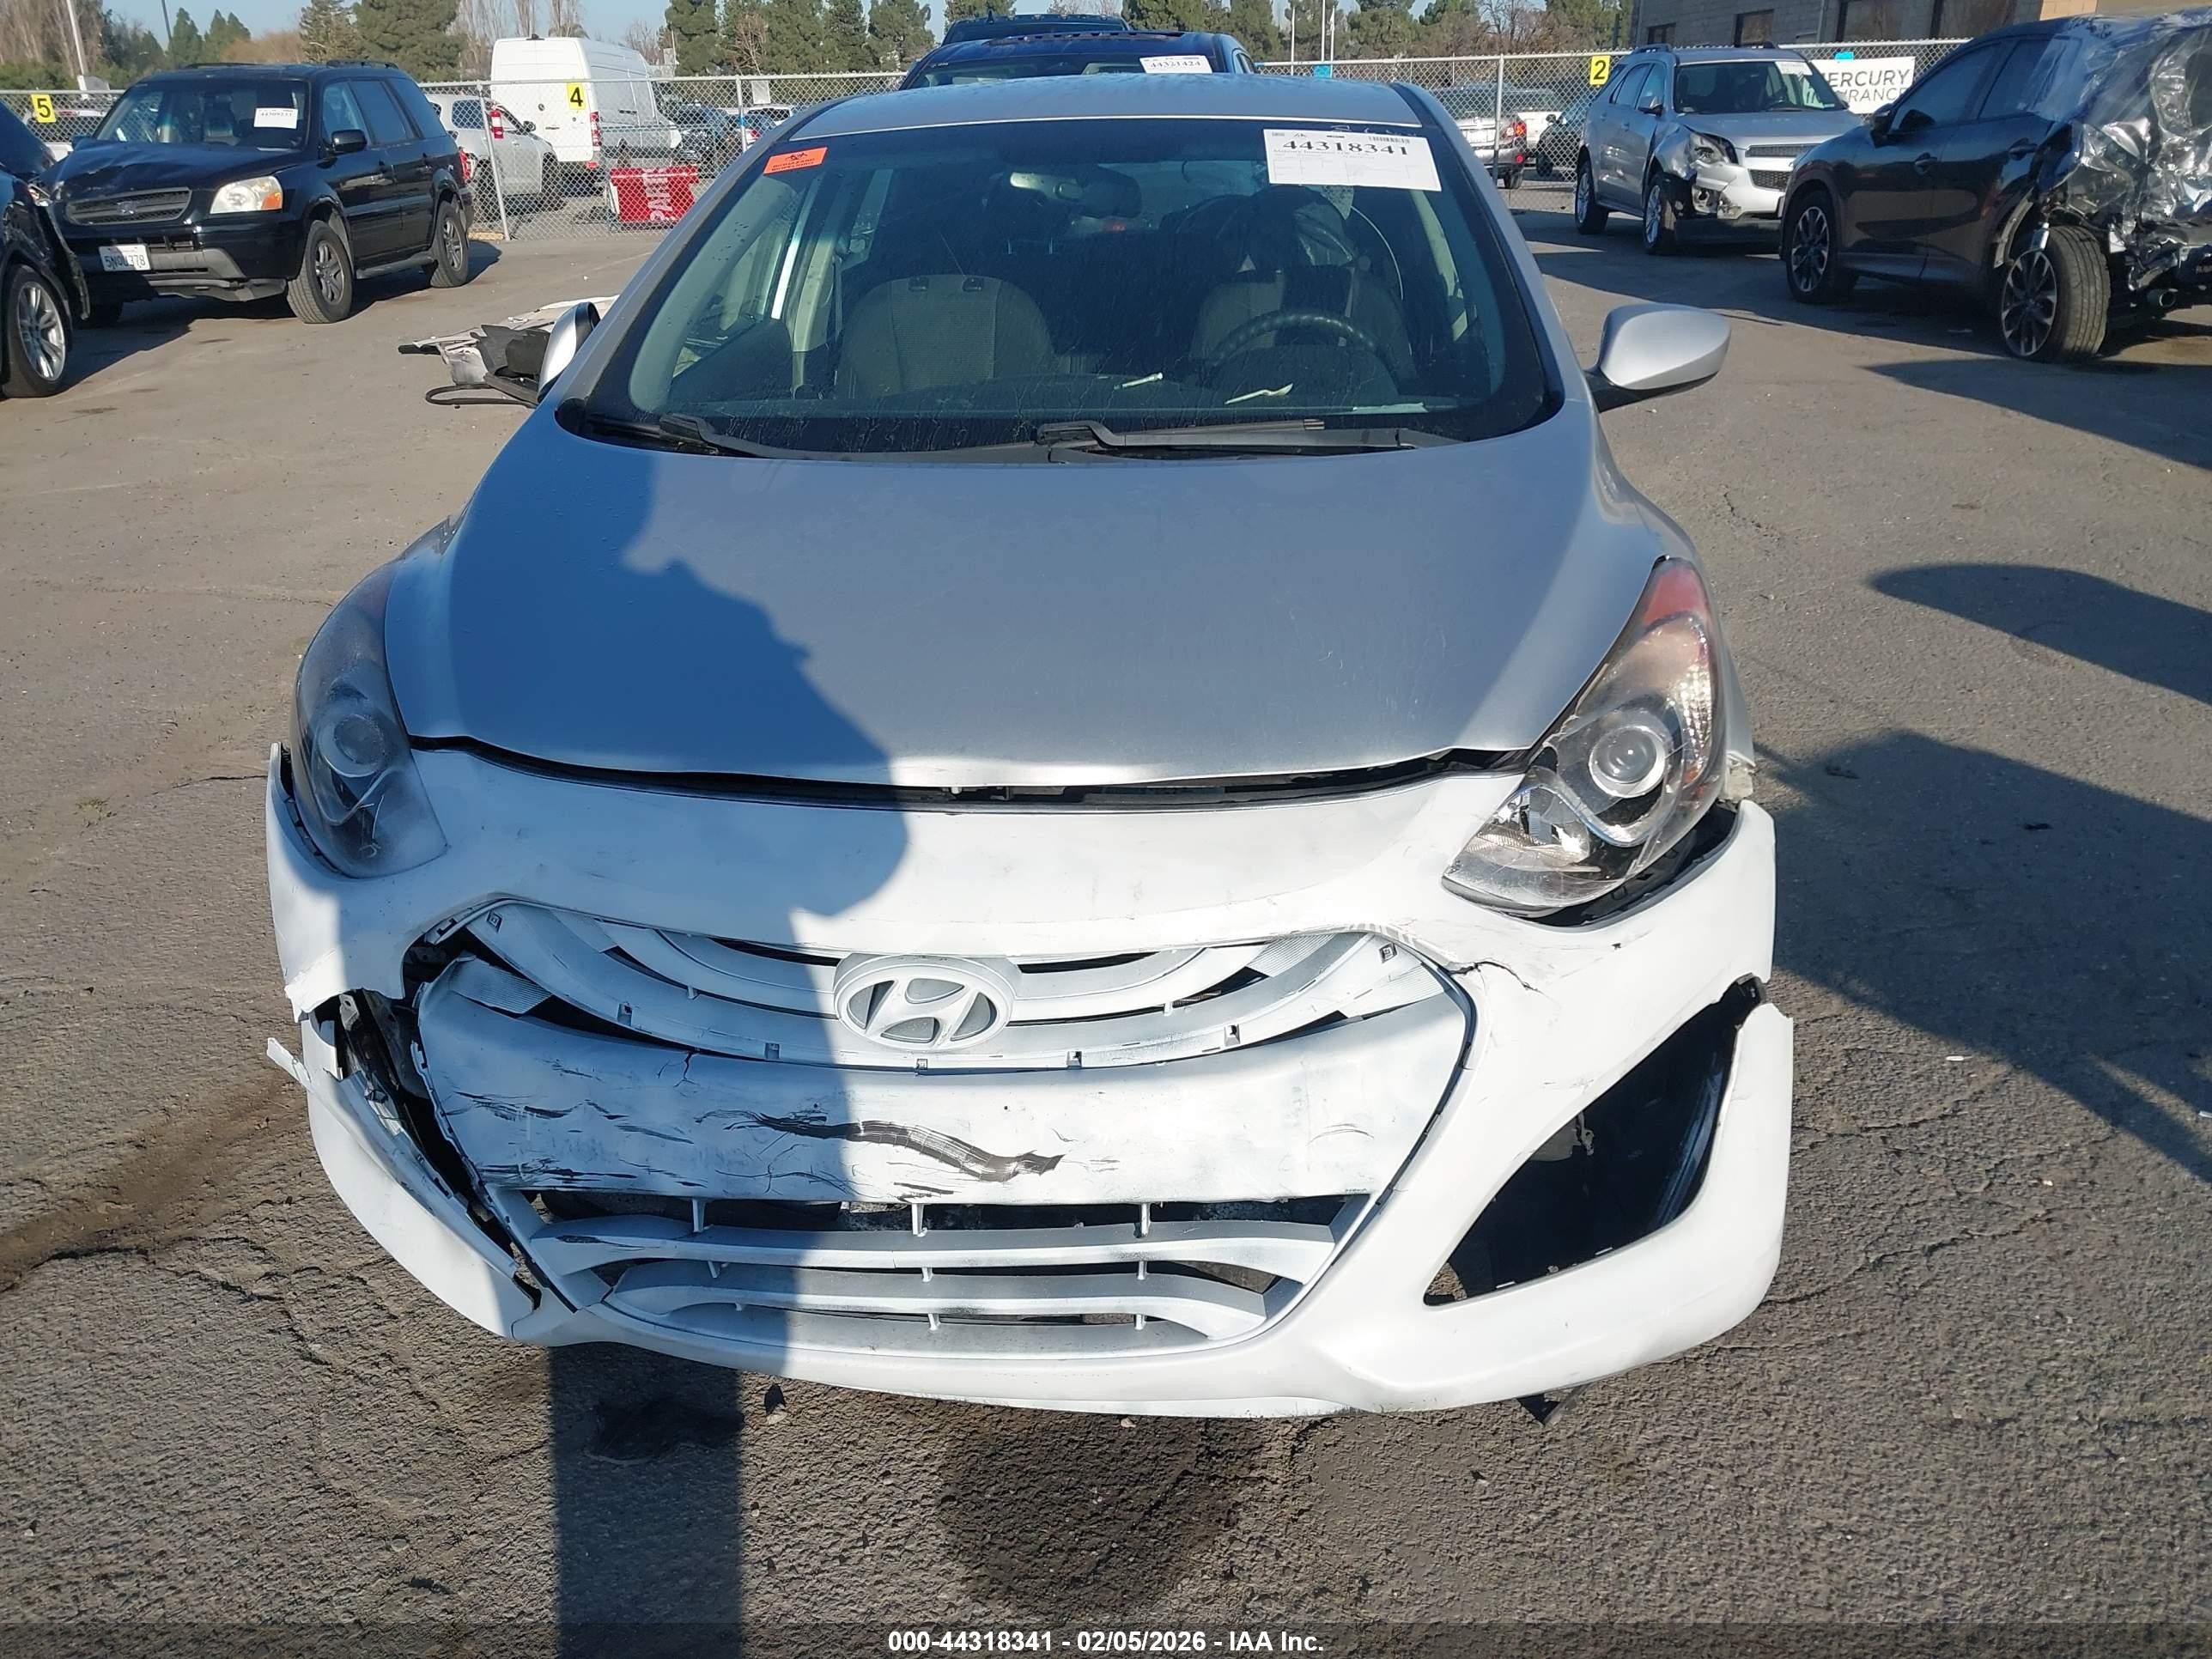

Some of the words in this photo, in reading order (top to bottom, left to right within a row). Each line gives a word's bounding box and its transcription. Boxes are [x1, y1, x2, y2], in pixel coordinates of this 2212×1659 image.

[1593, 60, 1607, 80] 2
[1820, 69, 1911, 88] ERCURY
[569, 87, 584, 107] 4
[37, 98, 51, 118] 5
[1282, 140, 1409, 156] 44318341
